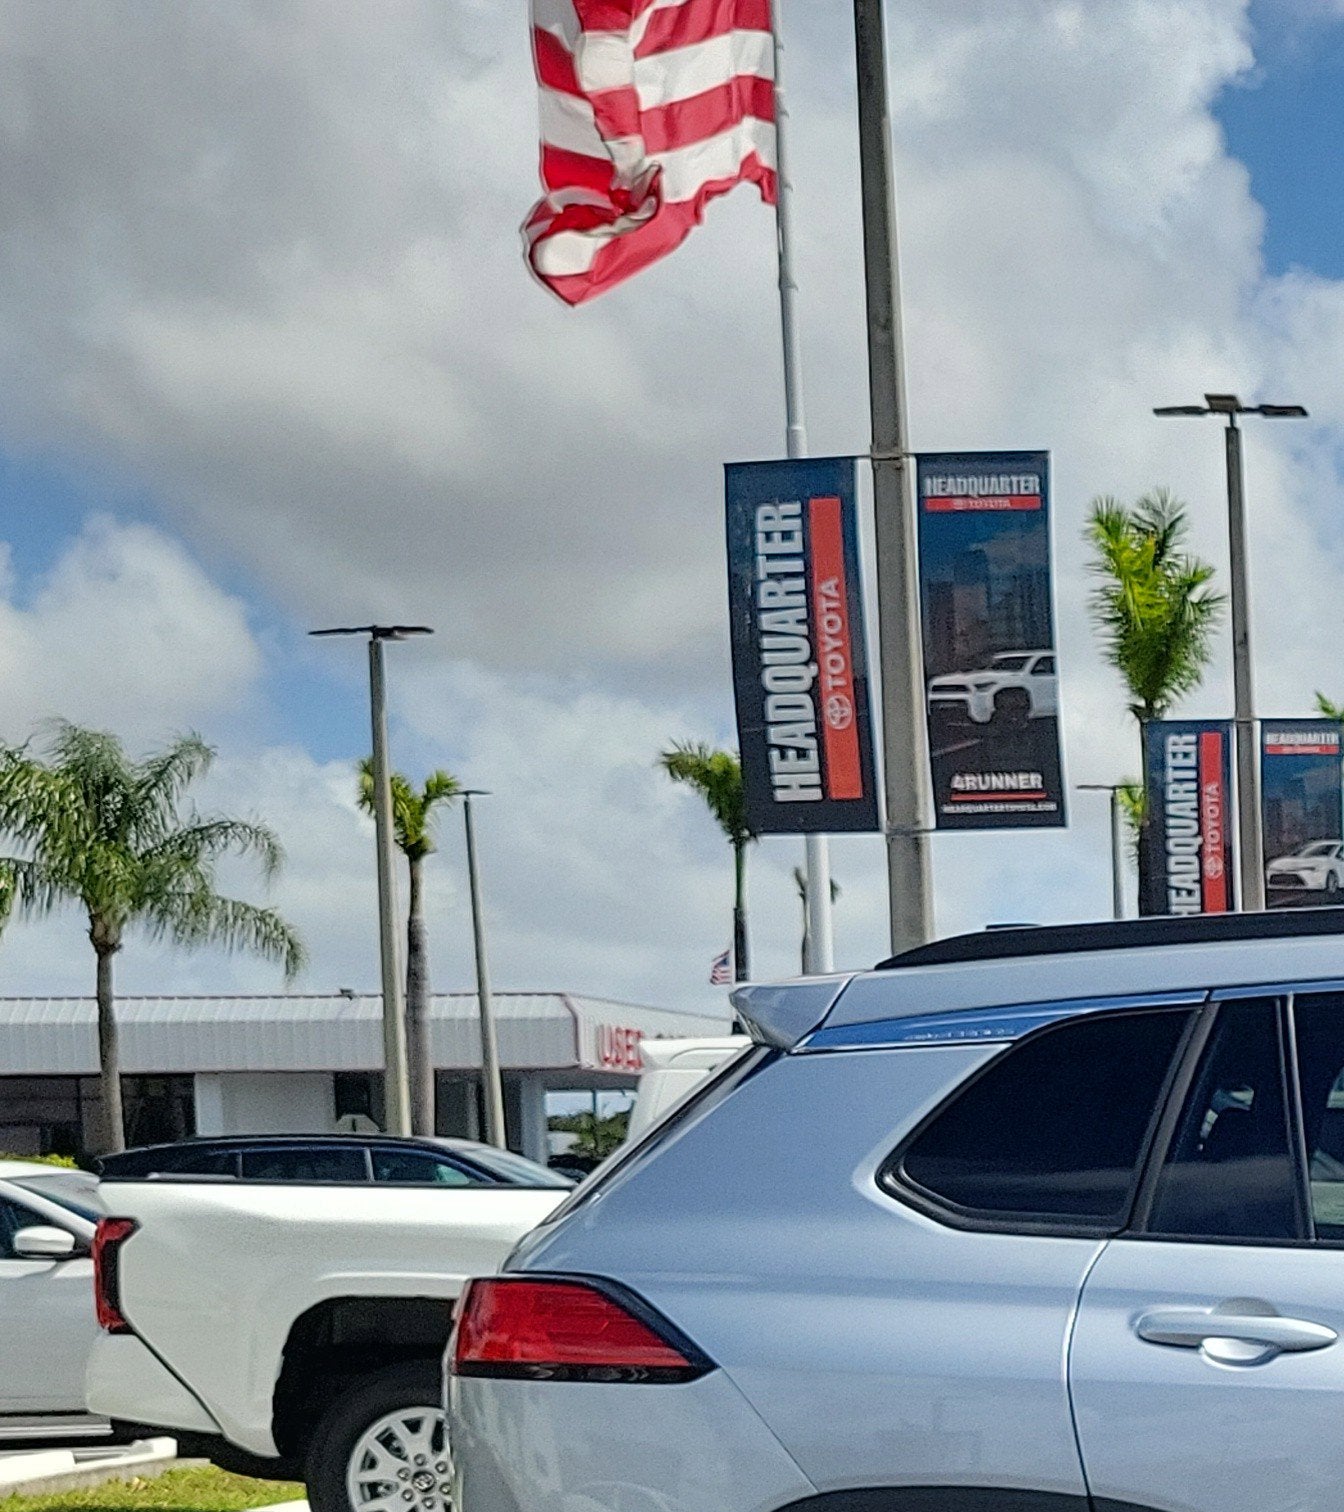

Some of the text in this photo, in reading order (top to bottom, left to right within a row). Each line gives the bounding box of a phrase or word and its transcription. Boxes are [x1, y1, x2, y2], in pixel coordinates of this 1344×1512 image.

[924, 474, 1041, 498] HEADQUARTER
[755, 500, 823, 803] HEADQUARTER
[819, 576, 848, 691] TOYOTA
[950, 771, 1044, 791] 4RUNNER
[1204, 782, 1222, 853] TOYOTA
